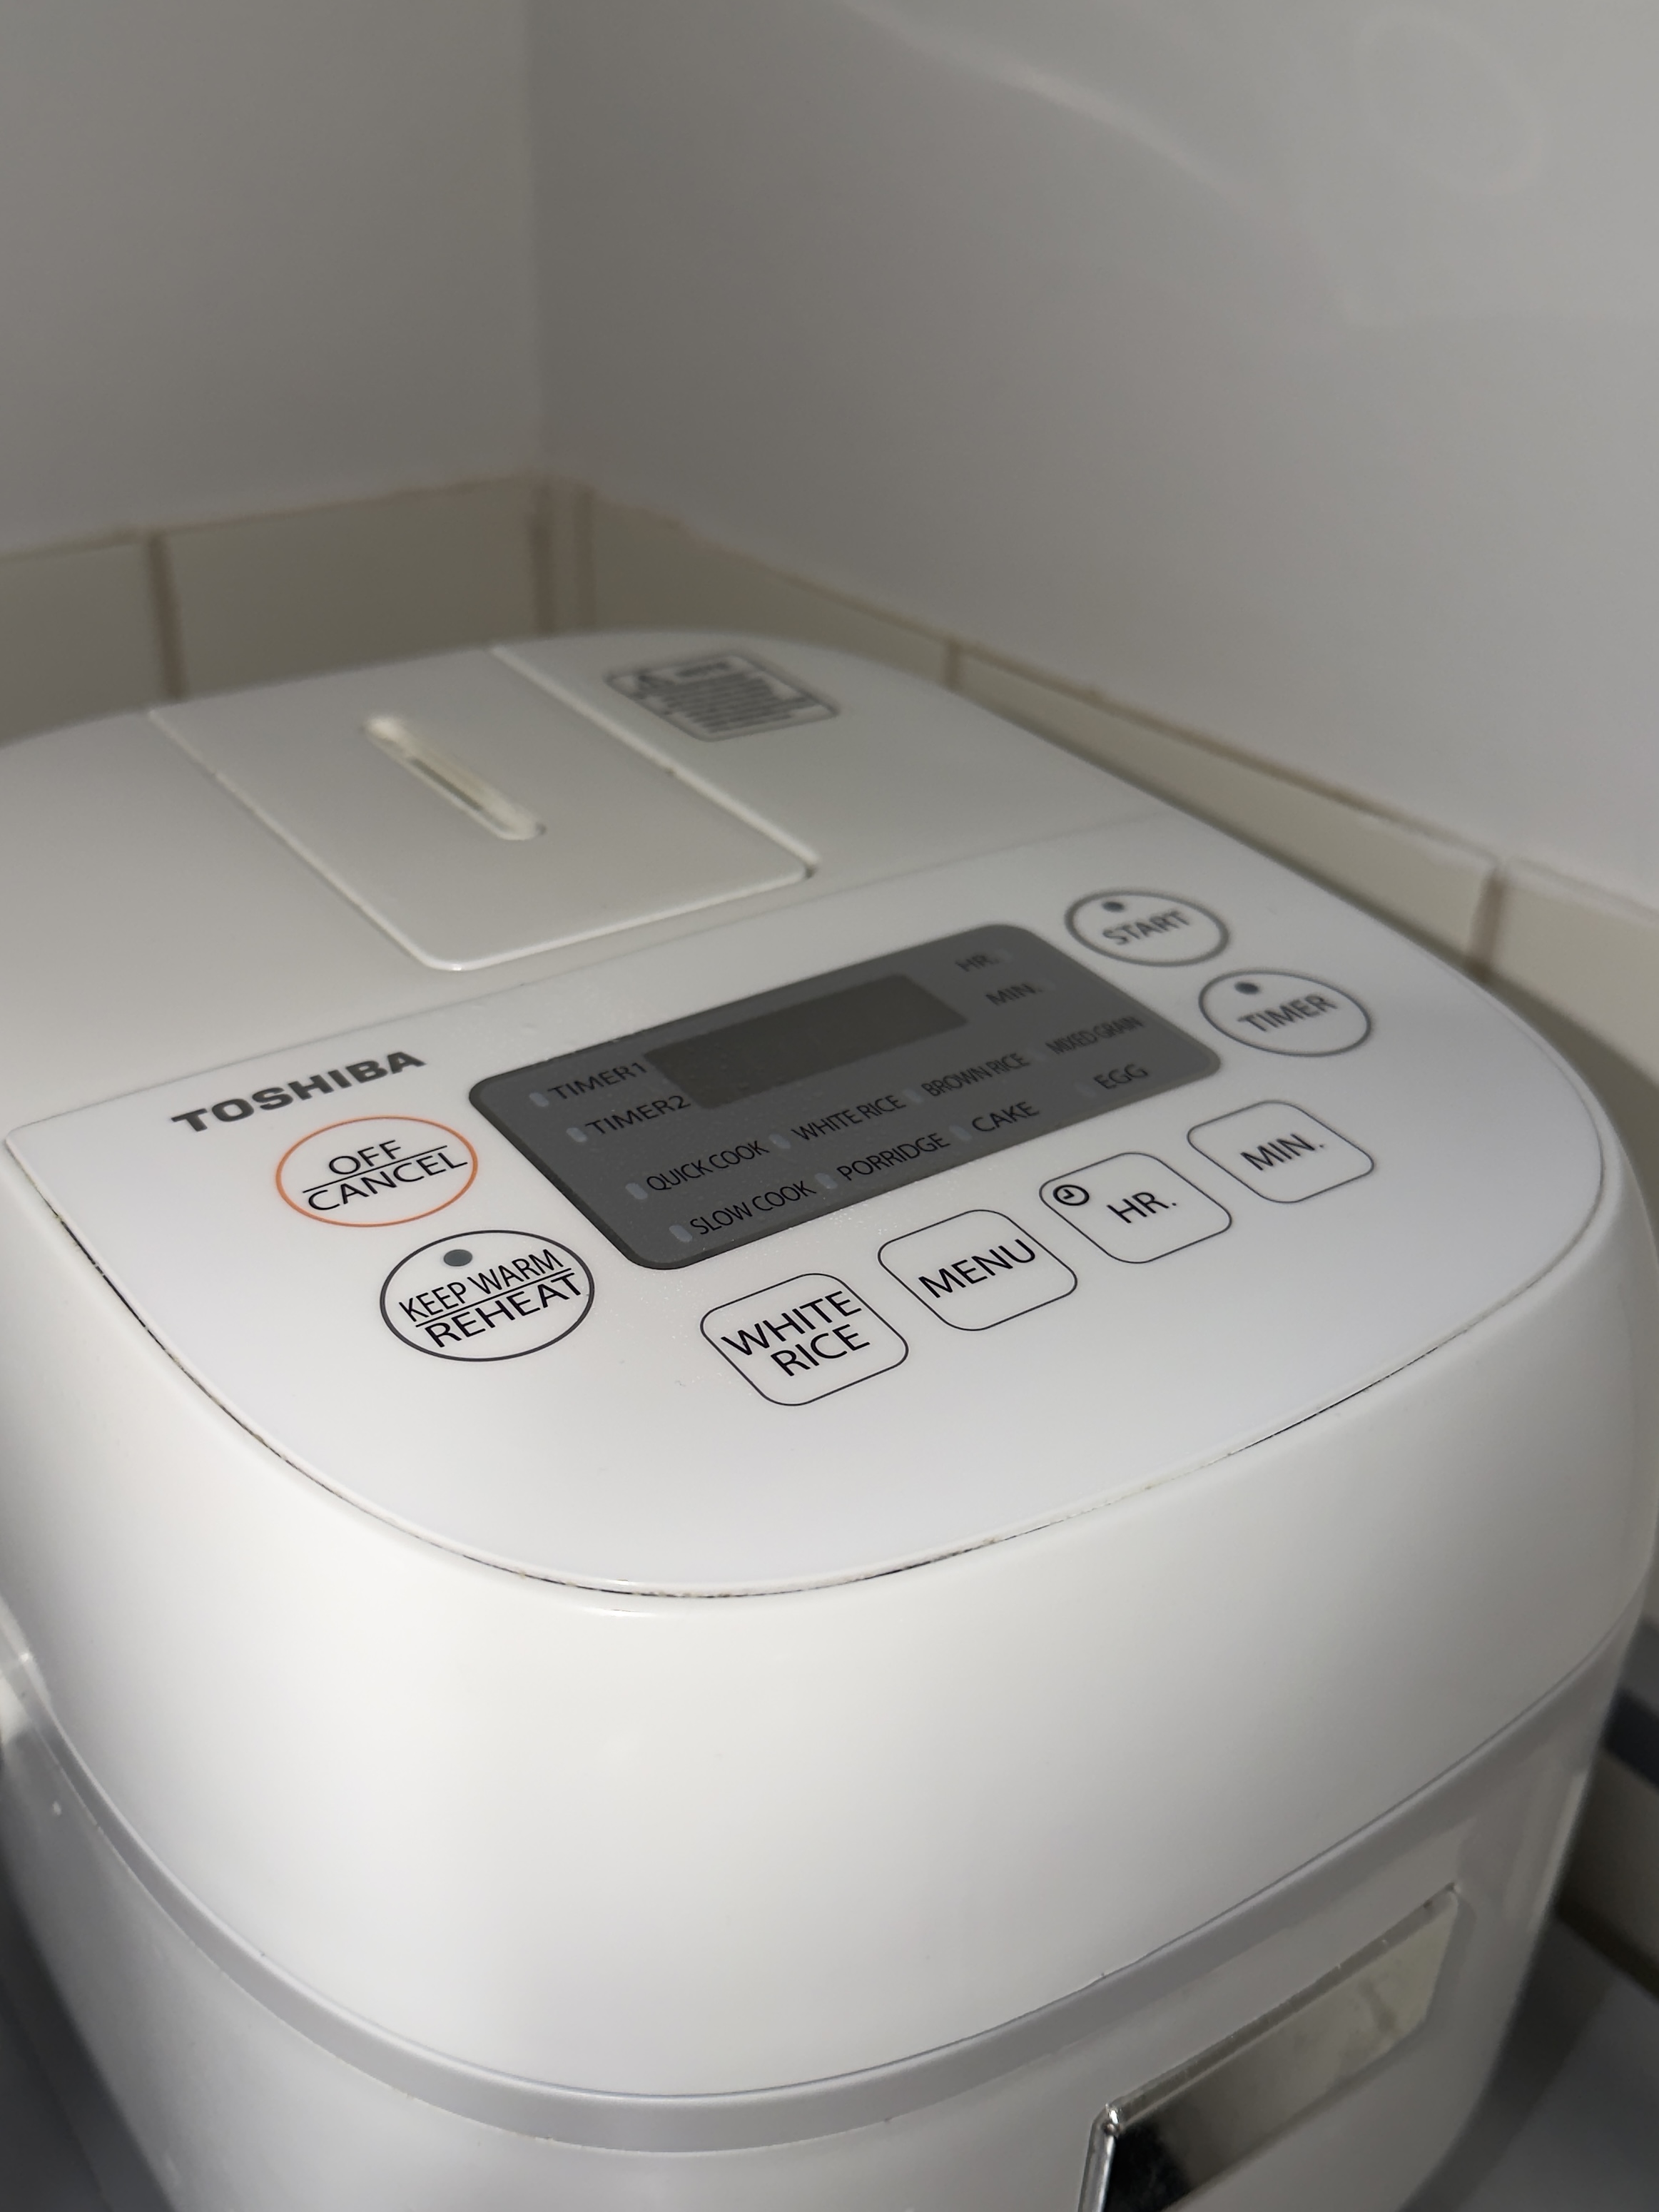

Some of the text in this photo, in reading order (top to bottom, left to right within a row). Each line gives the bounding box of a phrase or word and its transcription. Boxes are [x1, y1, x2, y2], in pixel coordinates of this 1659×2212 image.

[1102, 910, 1190, 945] START
[1045, 1015, 1145, 1055] MIXED GRAIN
[1237, 994, 1339, 1033] TIMER
[171, 1050, 427, 1133] TOSHIBA
[547, 1062, 648, 1100] TIMER1
[920, 1052, 1032, 1098] BROWN RICE
[1092, 1063, 1149, 1091] EGG
[585, 1095, 691, 1135] TIMER2
[791, 1094, 907, 1142] WHITE RICE
[971, 1101, 1041, 1133] CAKE
[328, 1140, 402, 1175] OFF
[646, 1140, 771, 1192] QUICK COOK
[836, 1132, 951, 1182] PORRIDGE
[1239, 1133, 1325, 1172] MIN.
[308, 1150, 469, 1211] CANCEL
[689, 1179, 817, 1236] SLOW COOK
[1106, 1189, 1177, 1224] HR.
[398, 1248, 564, 1322] KEEP WARM
[918, 1238, 1037, 1299] MENU
[423, 1272, 583, 1348] REHEAT
[721, 1290, 863, 1357] WHITE
[770, 1324, 871, 1378] RICE
